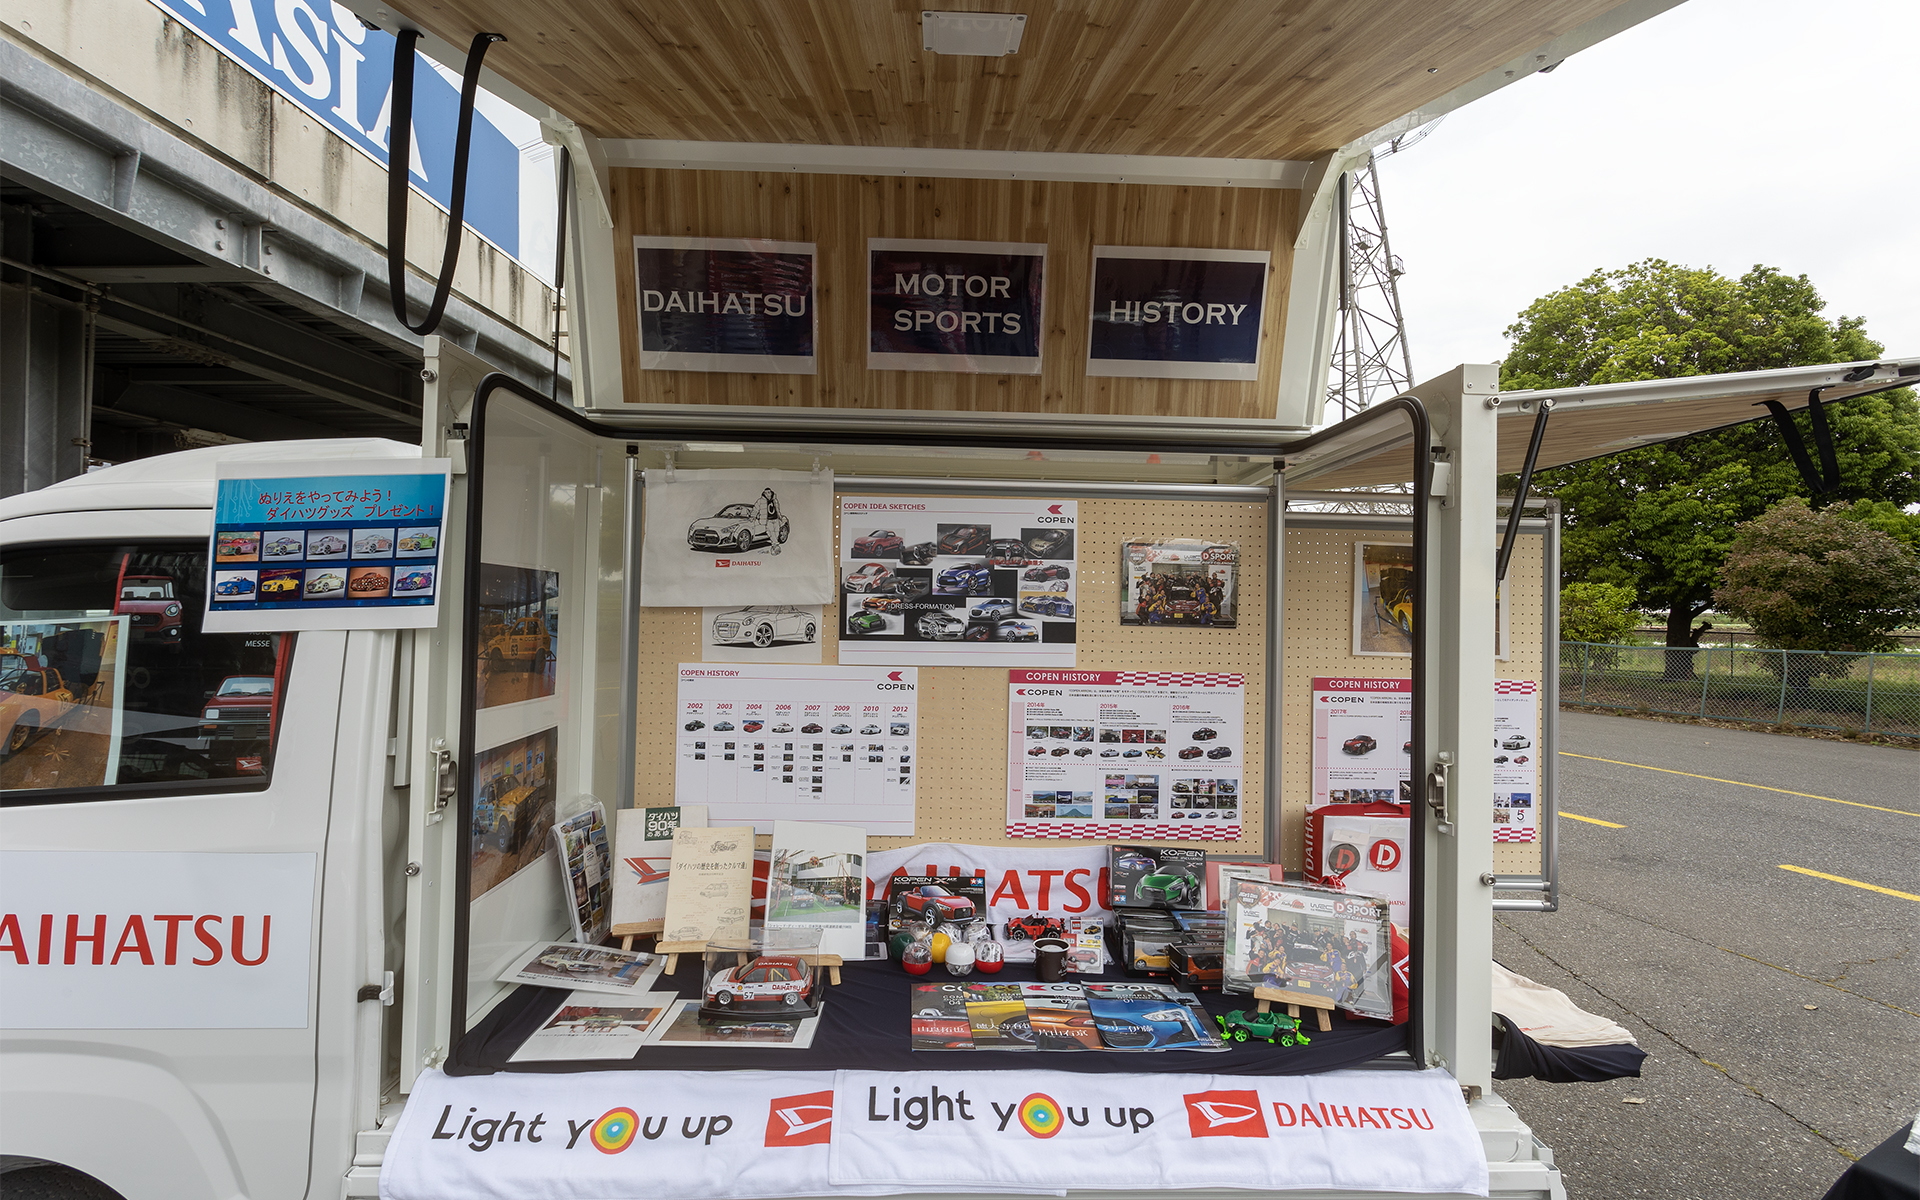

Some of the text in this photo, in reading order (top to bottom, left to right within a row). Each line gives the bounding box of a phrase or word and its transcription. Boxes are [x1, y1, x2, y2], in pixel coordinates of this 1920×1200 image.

[894, 273, 1012, 298] MOTOR
[643, 290, 808, 318] DAIHATSU
[1109, 299, 1247, 326] HISTORY
[893, 309, 1022, 336] SPORTS
[258, 489, 392, 506] ぬりえをやってみよう！
[267, 505, 433, 522] ダイハツグッズ プレゼント！
[889, 503, 926, 511] SKETCHES
[1210, 553, 1236, 561] SPORT
[245, 640, 271, 648] MESSE
[1026, 672, 1101, 682] COPEN HISTORY
[1329, 680, 1400, 689] COPEN HISTORY
[1027, 688, 1063, 696] COPEN
[648, 811, 679, 822] ダイハツ
[647, 820, 678, 832] 90年
[1160, 849, 1204, 857] KOPEN
[1346, 905, 1382, 918] SPORT
[0, 914, 271, 966] AIHATSU
[868, 1085, 975, 1131] Light
[1104, 1106, 1155, 1134] up
[1272, 1101, 1435, 1131] DAIHATSU
[431, 1104, 547, 1153] Light
[681, 1114, 734, 1146] up
